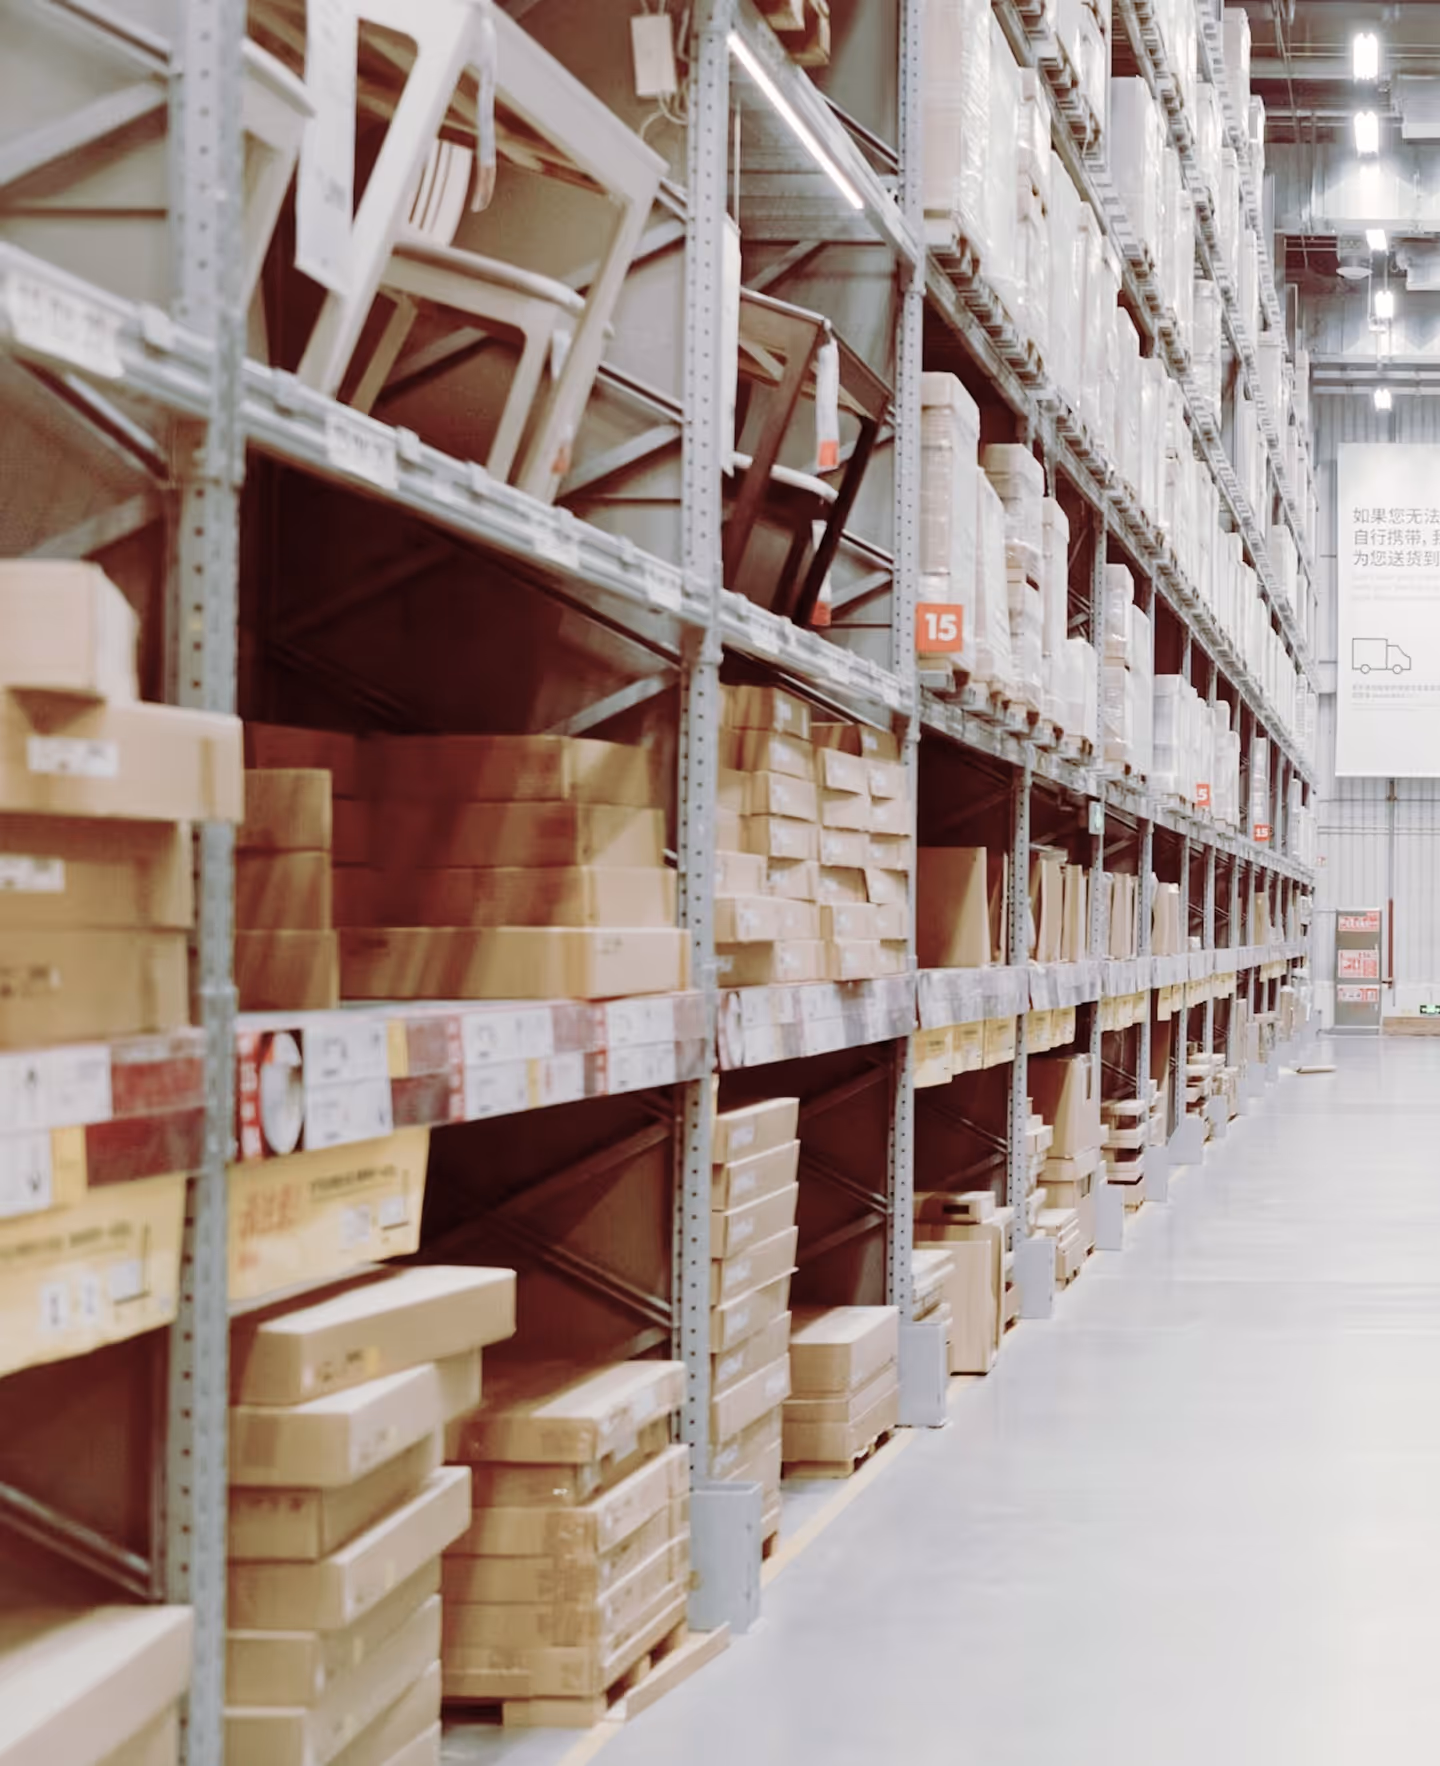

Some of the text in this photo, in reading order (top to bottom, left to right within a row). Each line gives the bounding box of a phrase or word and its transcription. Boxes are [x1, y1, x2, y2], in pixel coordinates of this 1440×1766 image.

[1353, 507, 1440, 524] 如果您无法
[925, 613, 957, 641] 15
